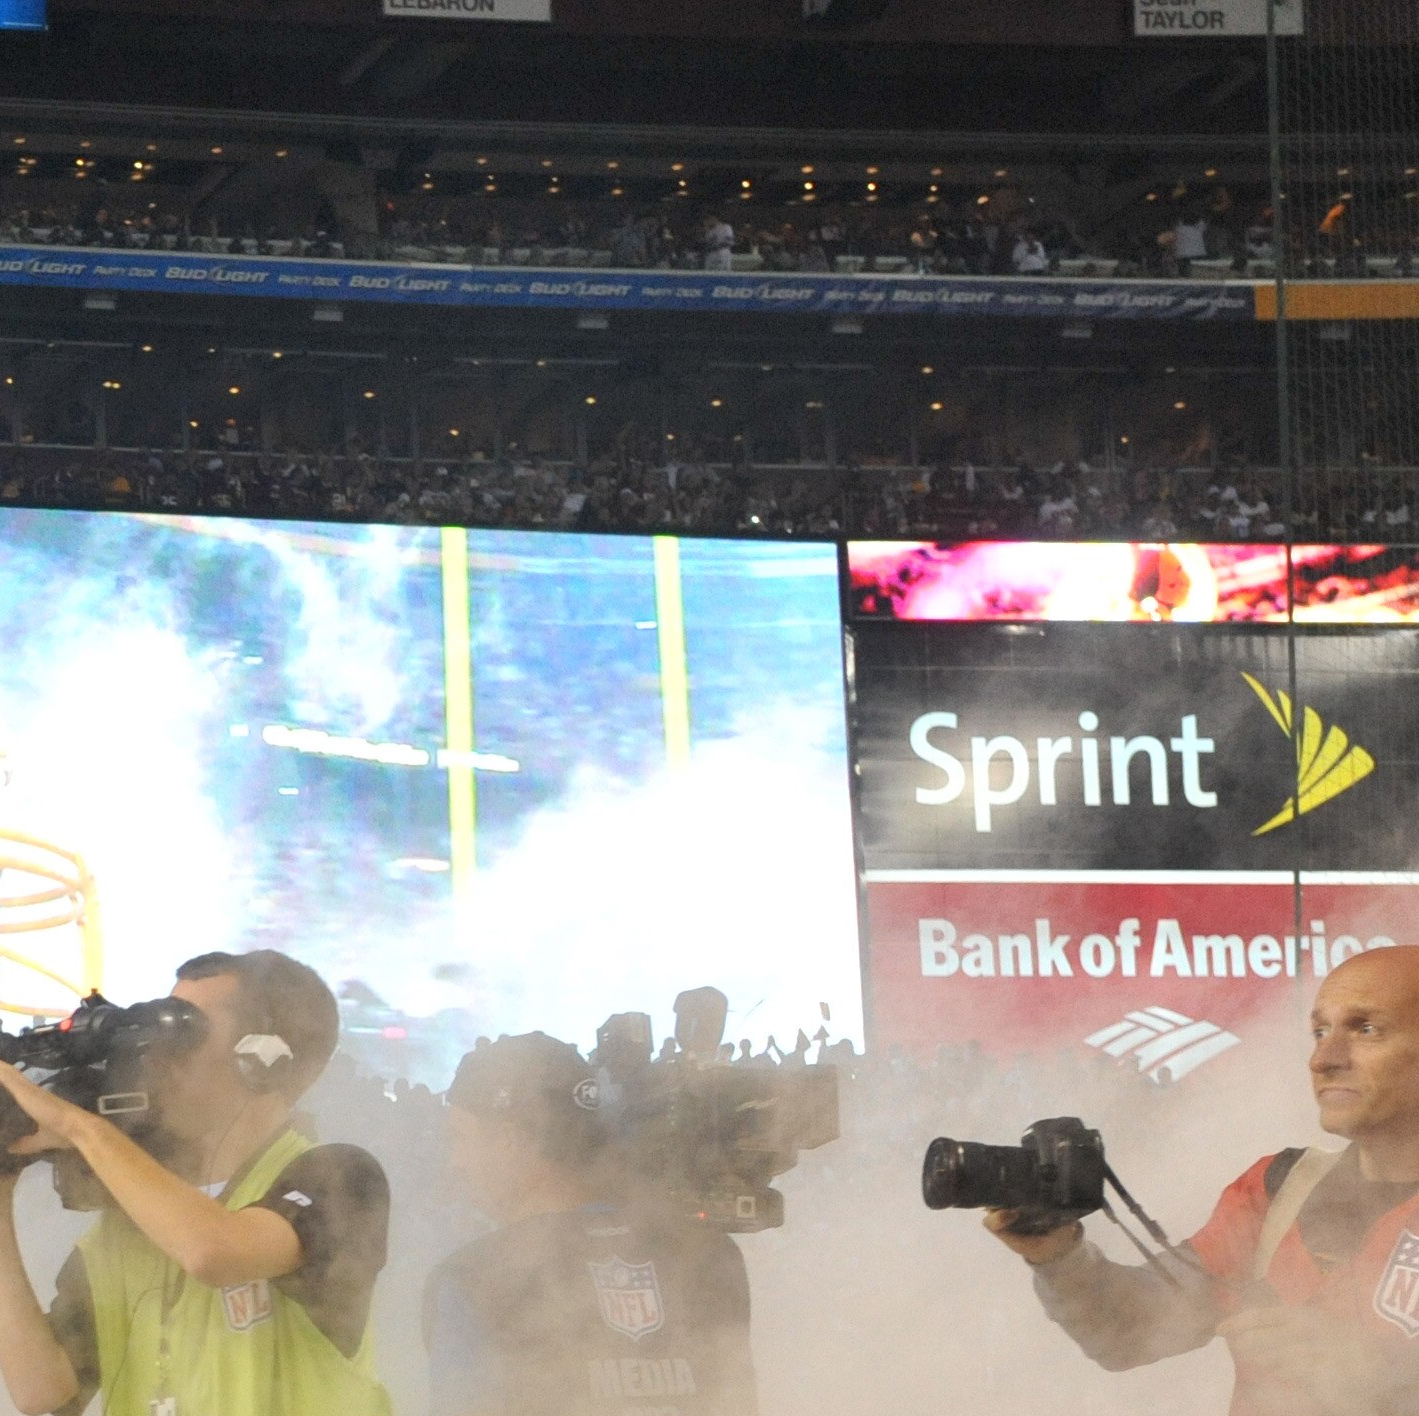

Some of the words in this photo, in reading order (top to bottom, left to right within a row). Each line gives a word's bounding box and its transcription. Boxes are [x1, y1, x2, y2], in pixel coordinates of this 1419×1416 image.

[1140, 10, 1225, 29] TAYLOR
[31, 261, 87, 275] LIGHT
[164, 266, 208, 281] BUD
[216, 269, 270, 284] LIGHT
[349, 275, 391, 290] BUD
[398, 278, 452, 293] LIGHT
[908, 710, 1218, 833] Sprint
[919, 918, 1072, 978] Bank
[1079, 917, 1141, 978] of
[1149, 918, 1397, 978] Americ
[230, 1283, 269, 1324] NL
[588, 1358, 697, 1398] MEDIA
